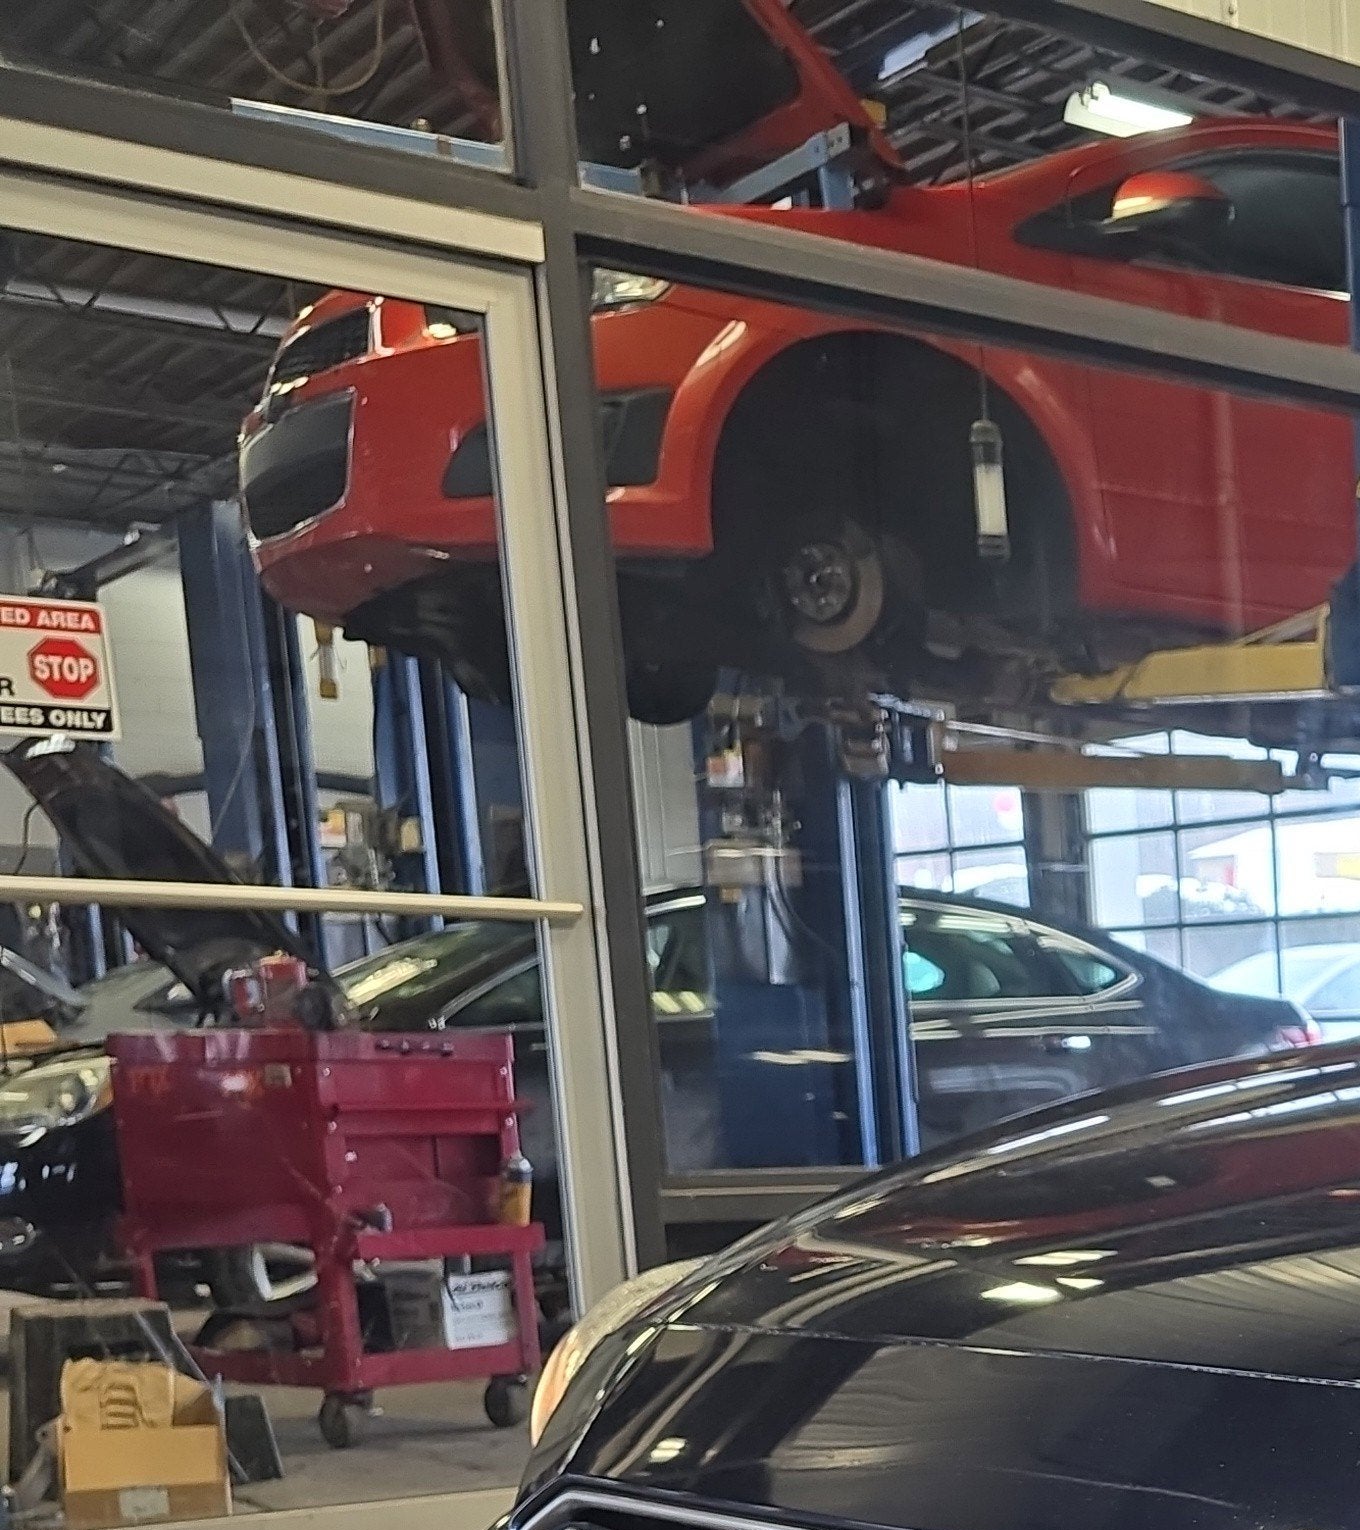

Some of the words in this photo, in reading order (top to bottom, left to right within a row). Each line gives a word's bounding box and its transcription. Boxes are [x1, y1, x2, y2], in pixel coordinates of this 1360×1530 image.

[36, 610, 96, 631] AREA
[34, 654, 94, 684] STOP
[48, 708, 107, 730] ONLY
